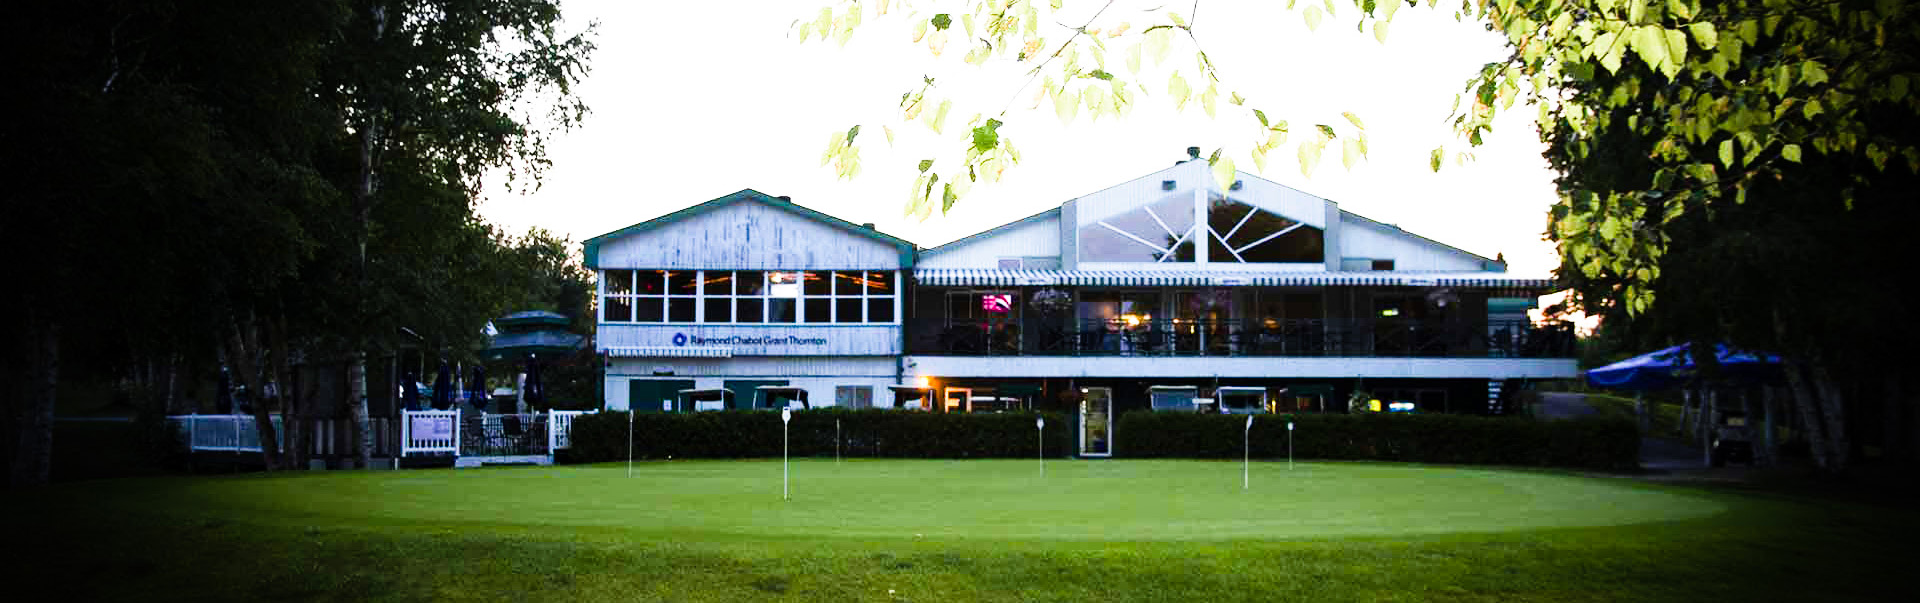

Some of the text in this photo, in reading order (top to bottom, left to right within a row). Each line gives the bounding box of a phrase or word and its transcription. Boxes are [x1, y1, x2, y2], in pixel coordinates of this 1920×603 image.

[691, 335, 730, 346] Raymond
[763, 335, 787, 345] Grant
[788, 335, 827, 345] Thornton
